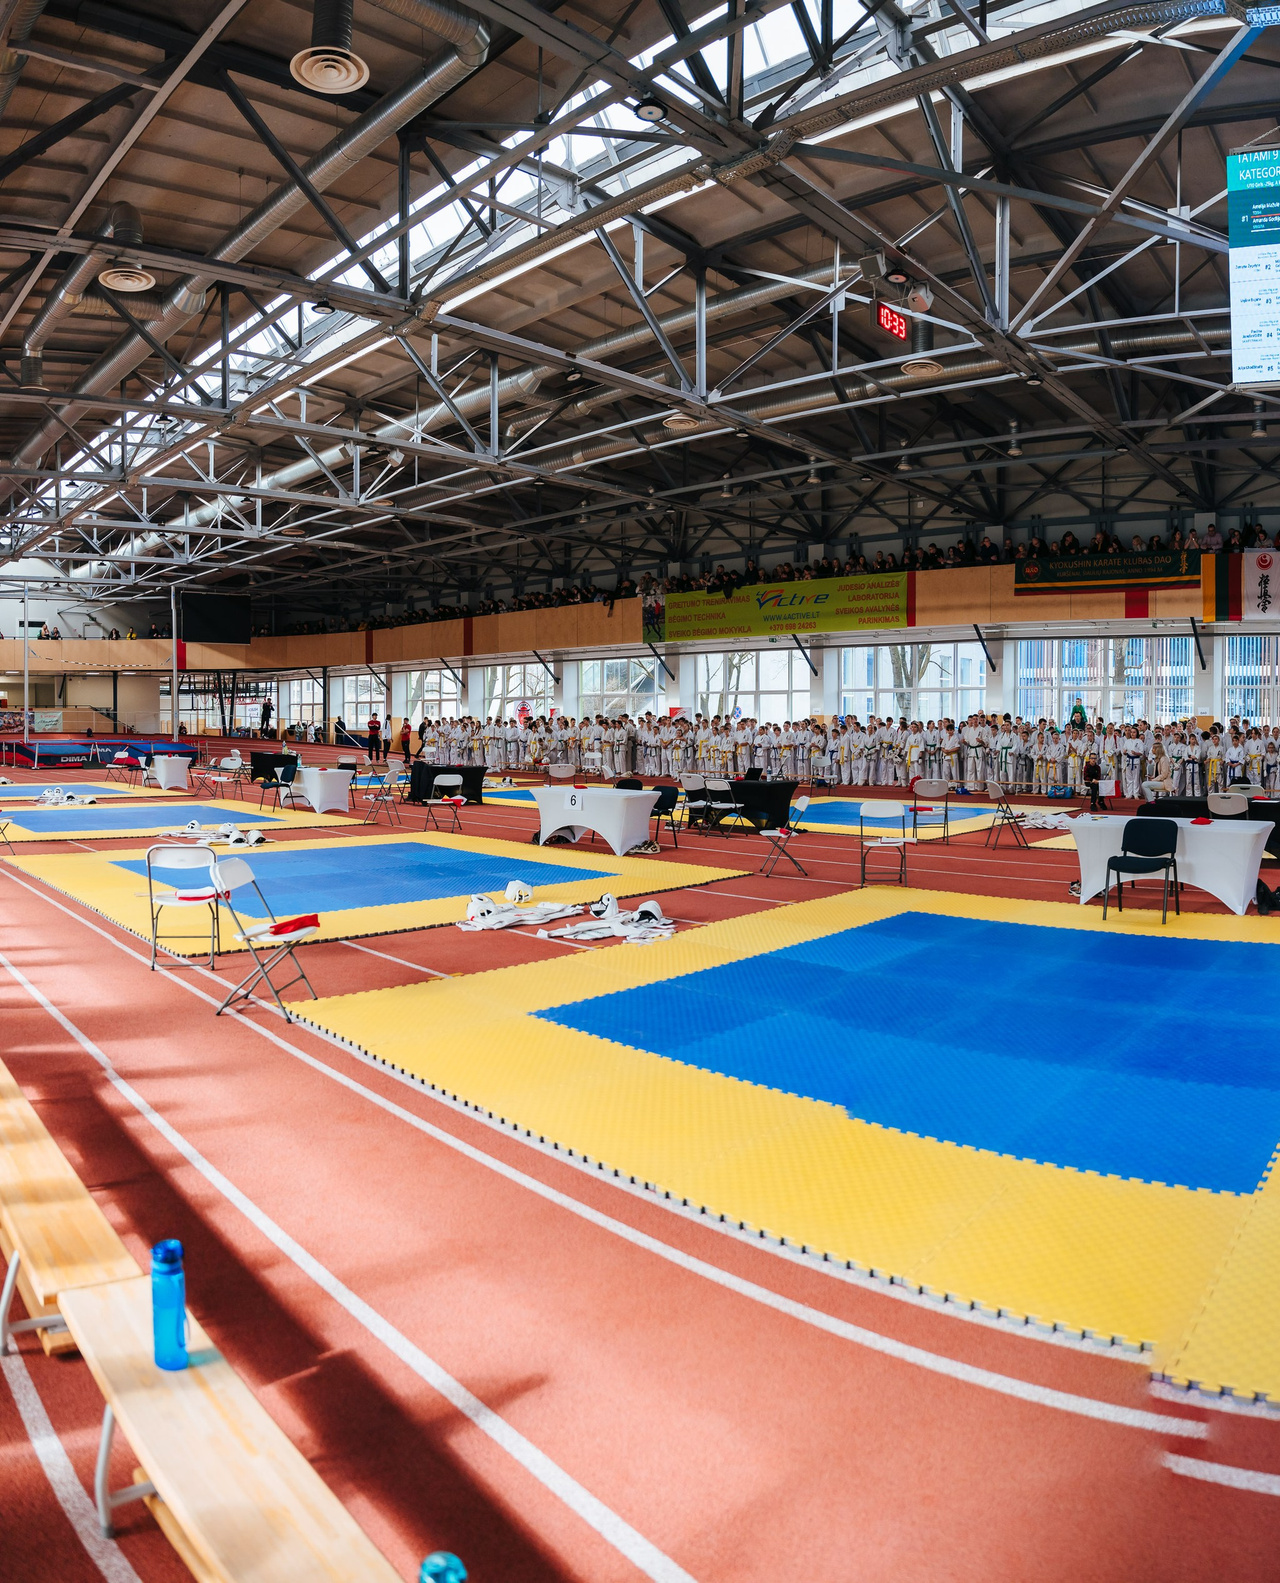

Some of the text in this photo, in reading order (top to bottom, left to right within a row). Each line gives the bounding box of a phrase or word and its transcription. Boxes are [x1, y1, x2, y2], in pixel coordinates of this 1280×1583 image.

[1272, 150, 1278, 160] 9
[881, 307, 906, 338] 10:33
[1049, 555, 1172, 569] KYOKUSHIN KARATE KLUBAS DAO
[837, 580, 900, 591] JUDESIO ANALIZĖS
[848, 592, 900, 602] LABORATORIJA
[668, 600, 701, 609] GREITUMO
[835, 603, 900, 615] SVEIKOS AVALYNĖS
[668, 612, 726, 623] BĖGIMO TECHNIKA
[763, 611, 821, 621] WWW.4ACTIVE.LT
[858, 615, 900, 624] PARINKIMAS
[668, 625, 752, 638] SVEIKO BĖGIMO MOKYKLA
[769, 623, 784, 631] +370
[60, 755, 88, 763] DIMA
[570, 794, 577, 806] 6
